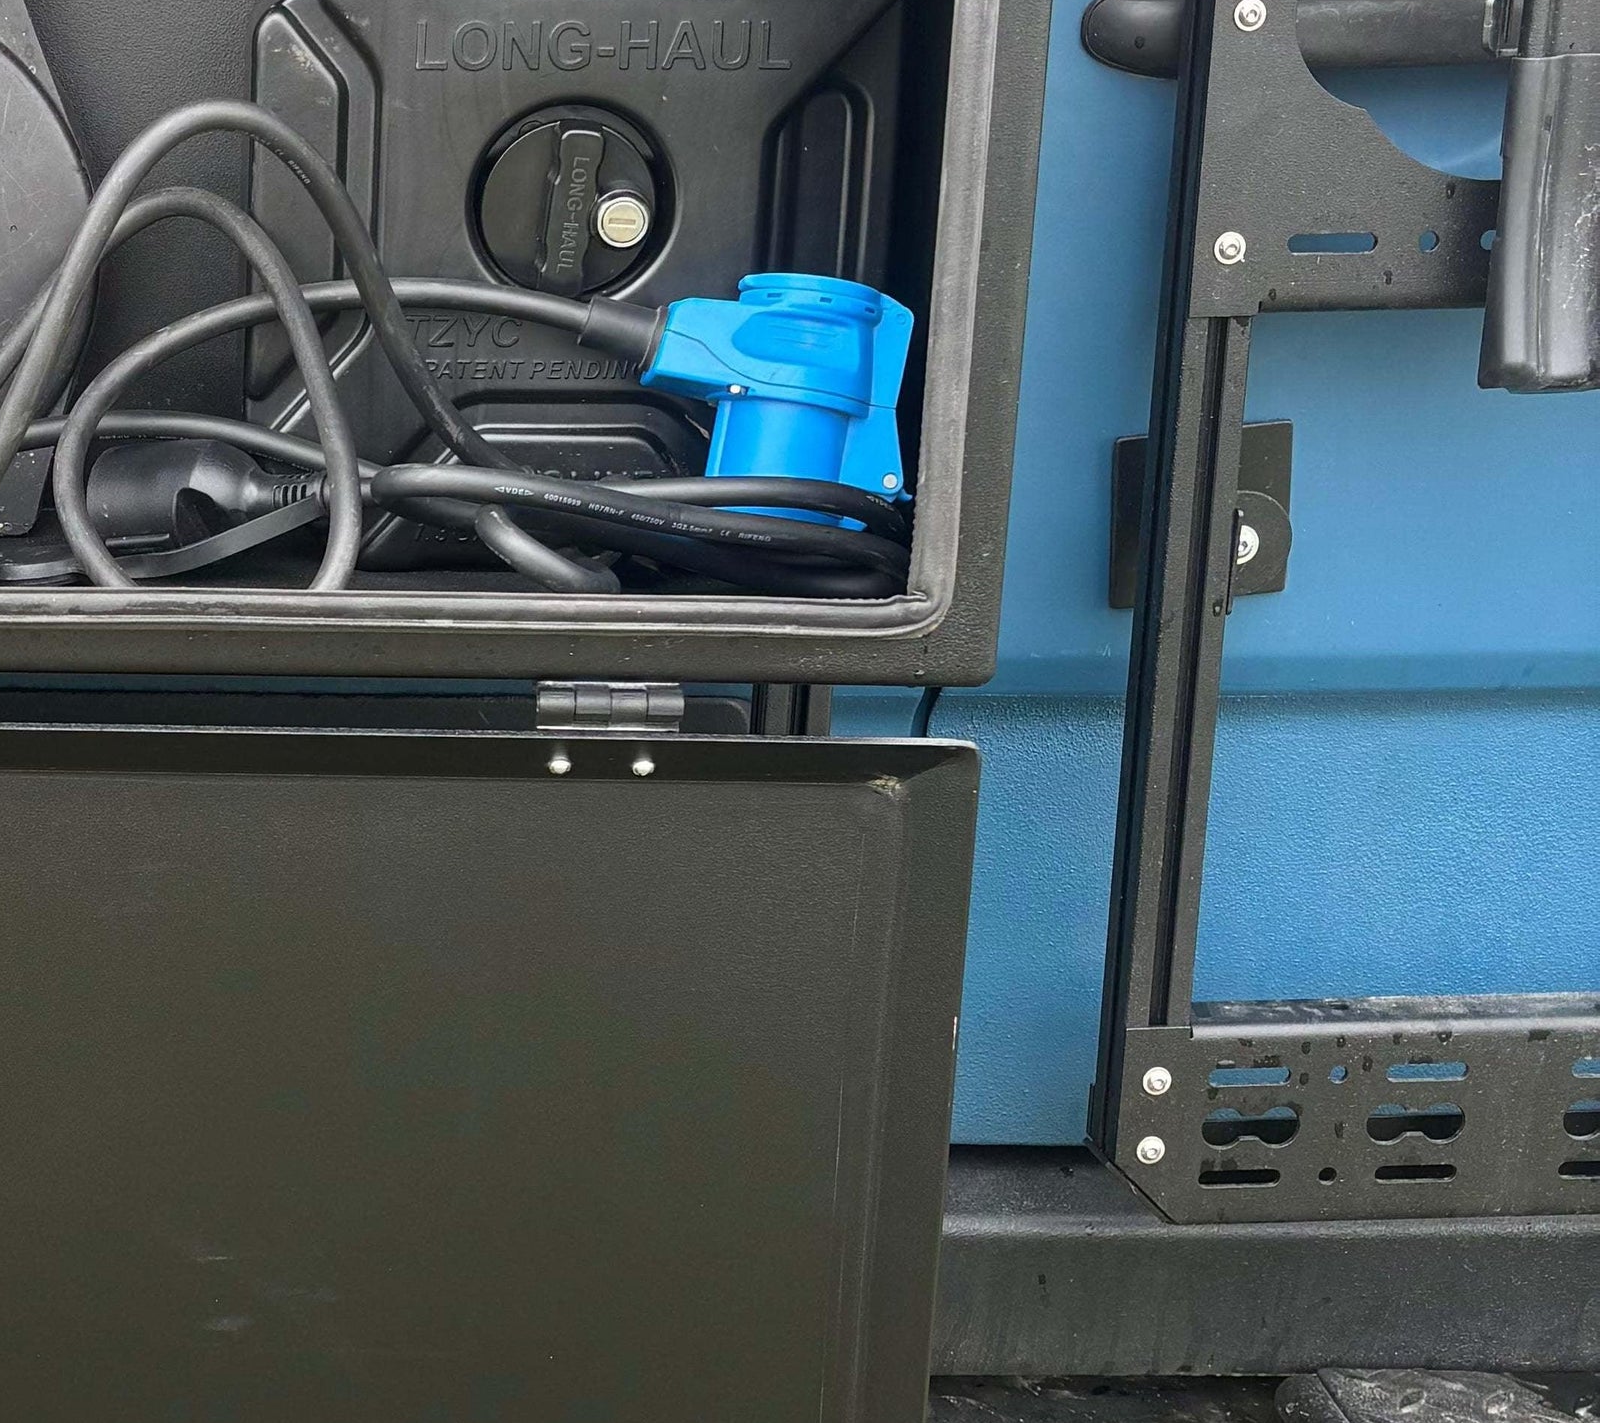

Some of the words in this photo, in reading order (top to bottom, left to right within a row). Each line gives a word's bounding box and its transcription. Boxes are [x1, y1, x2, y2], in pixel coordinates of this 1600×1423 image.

[415, 19, 792, 72] LONG-HAUL
[555, 155, 591, 274] LONG-HAUL
[425, 359, 525, 381] PATENT
